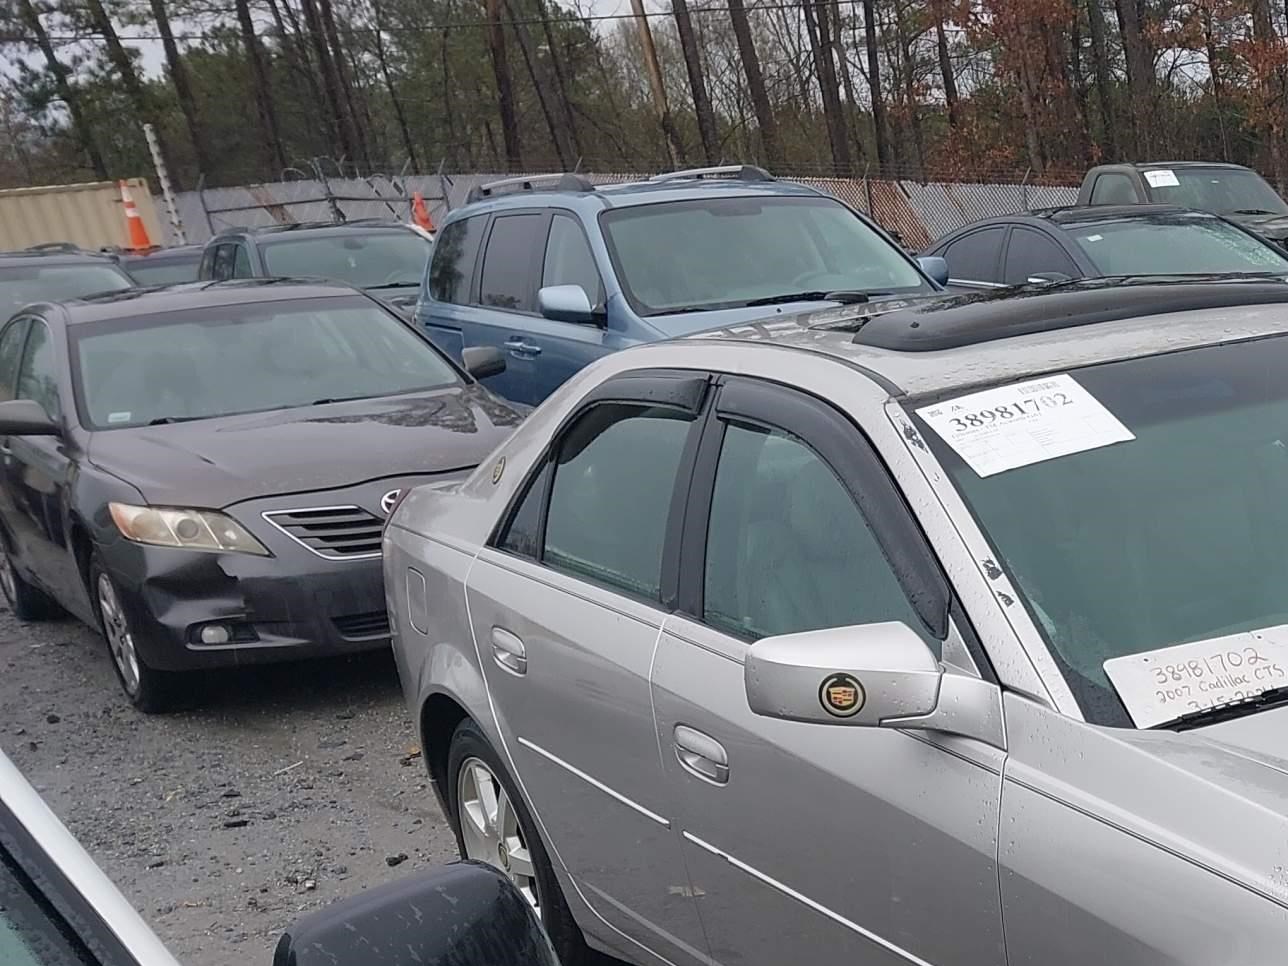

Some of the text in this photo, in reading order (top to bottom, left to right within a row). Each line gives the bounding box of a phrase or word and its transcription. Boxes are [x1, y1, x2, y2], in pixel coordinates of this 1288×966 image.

[949, 392, 1074, 432] 38981702
[1151, 647, 1268, 684] 38981702
[1156, 663, 1286, 703] 2007 Cadillac CTS
